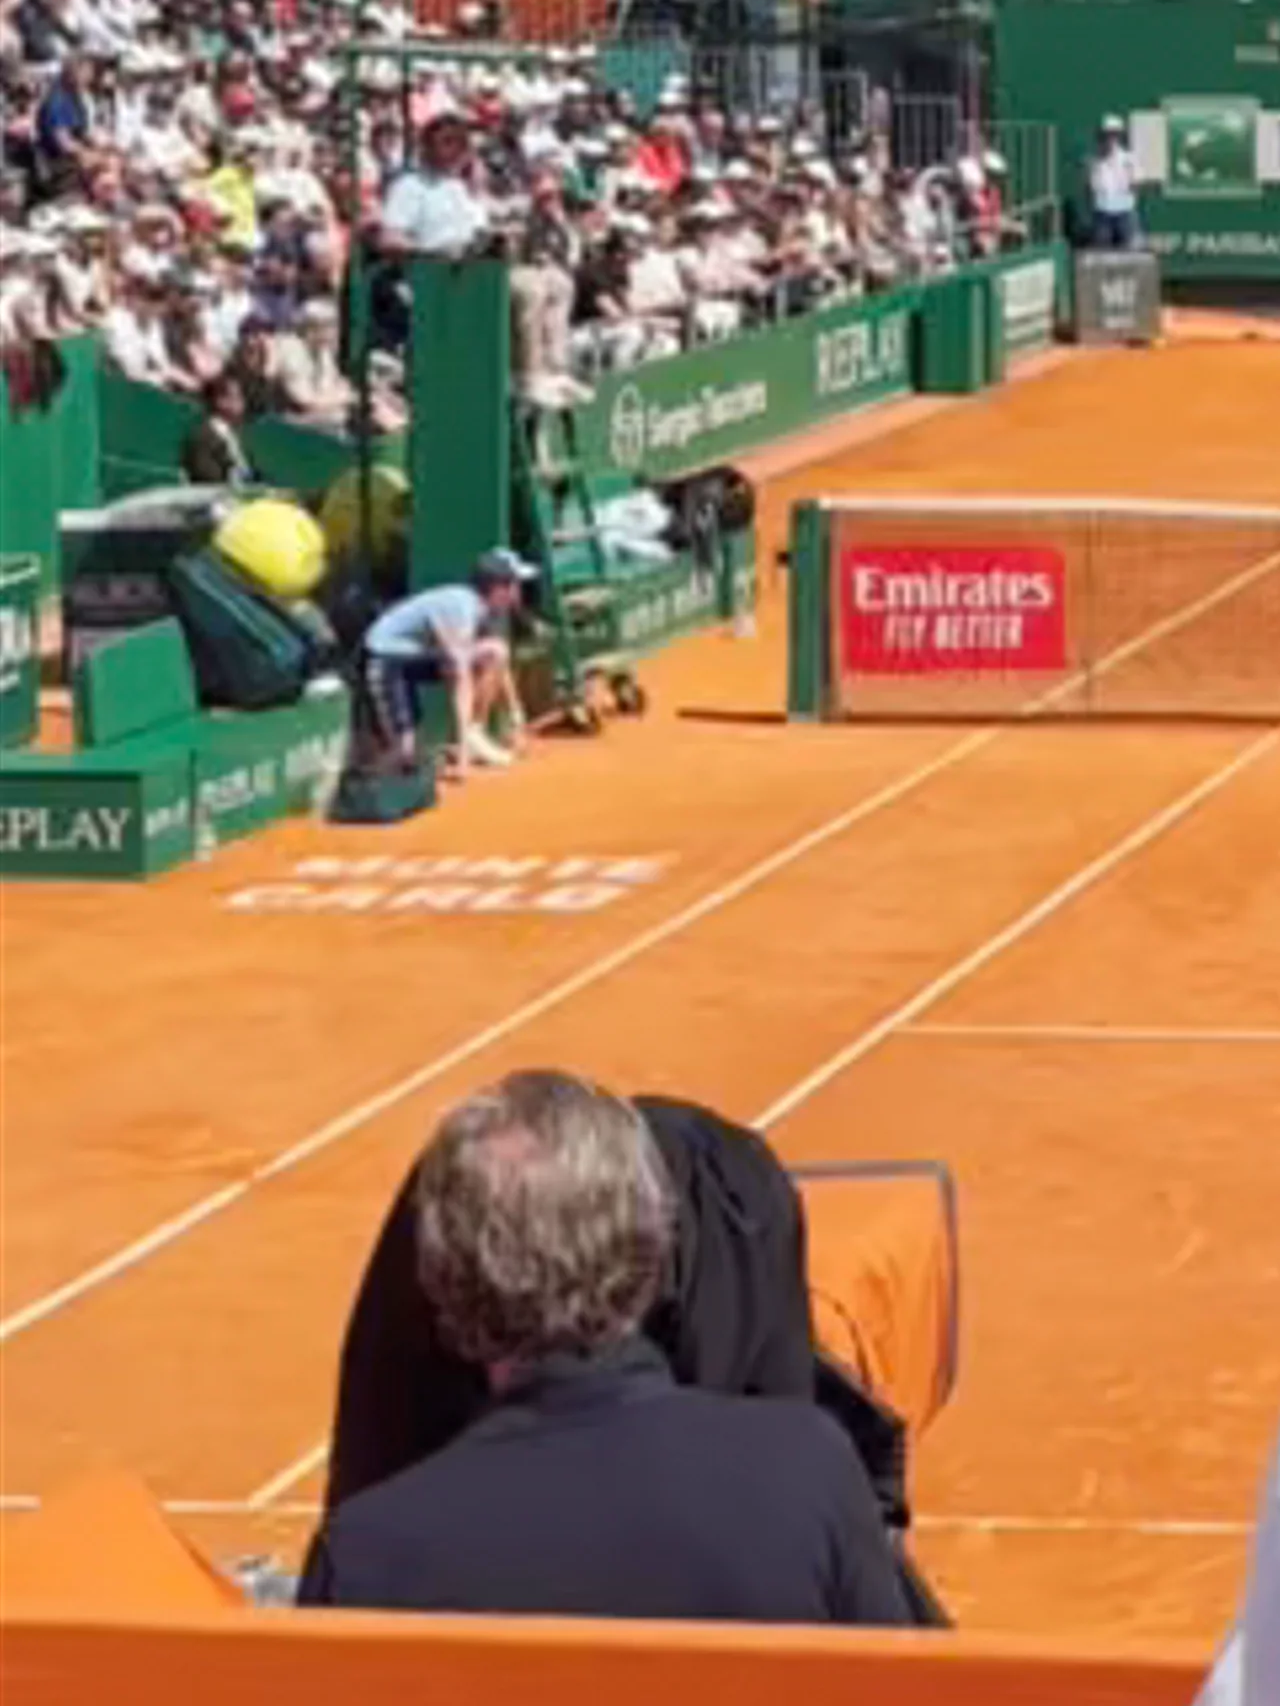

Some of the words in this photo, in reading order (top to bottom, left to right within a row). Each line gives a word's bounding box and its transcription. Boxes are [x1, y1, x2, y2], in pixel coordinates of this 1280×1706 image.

[852, 566, 1054, 612] Emirates
[885, 614, 930, 648] FLY
[934, 614, 1025, 649] BETTER
[0, 807, 131, 851] EPLAY
